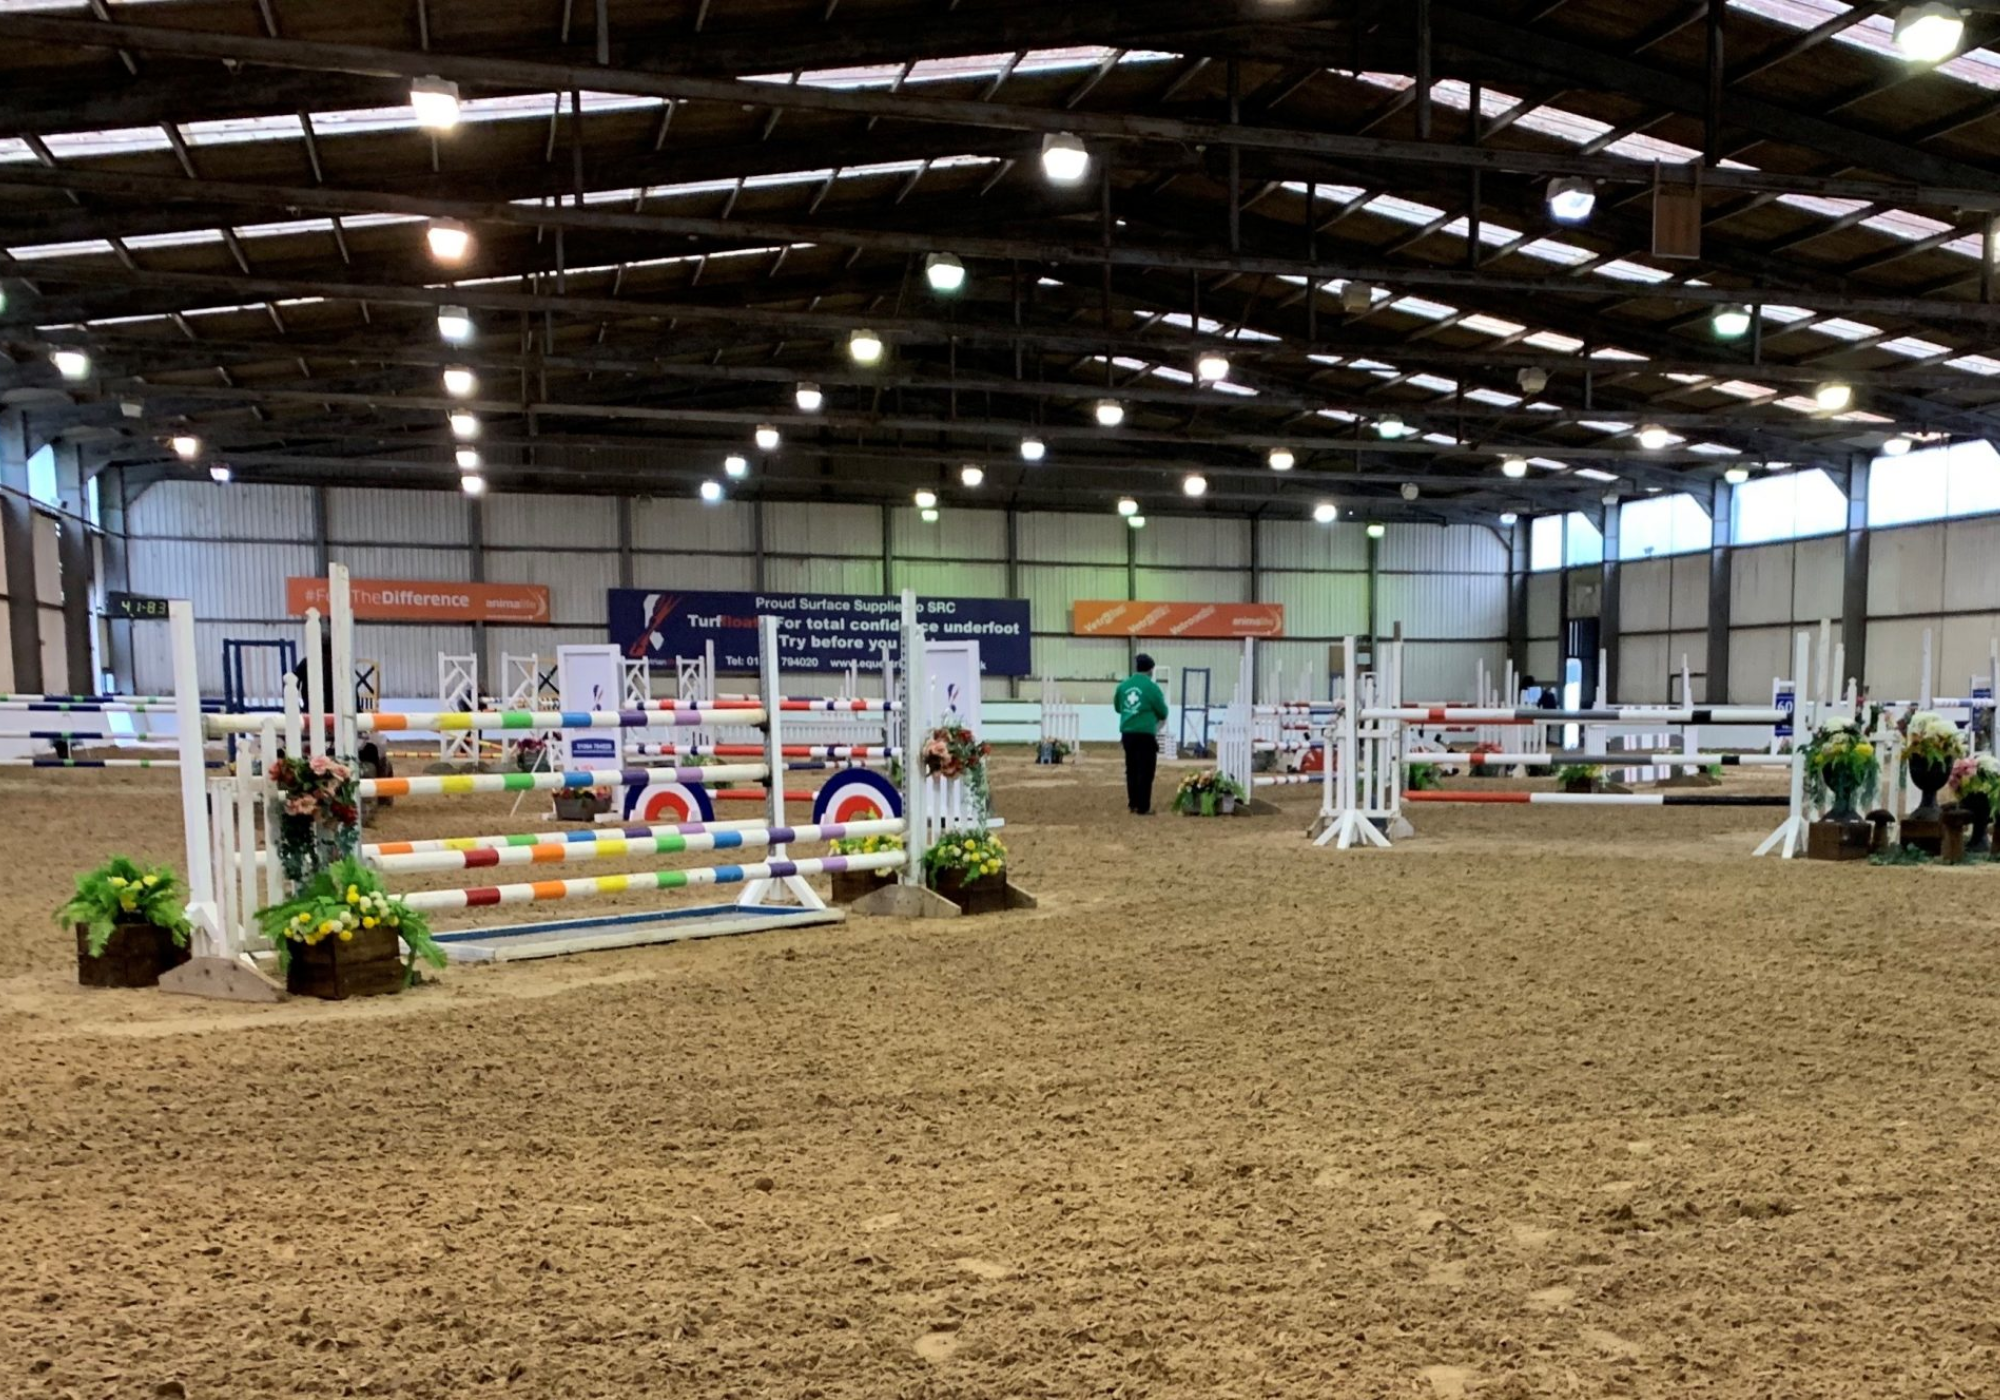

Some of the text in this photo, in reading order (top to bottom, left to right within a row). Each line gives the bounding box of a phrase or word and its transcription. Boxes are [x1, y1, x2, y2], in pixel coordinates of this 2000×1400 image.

[305, 588, 469, 608] #FTheDifference
[755, 597, 796, 609] Proud
[799, 598, 850, 612] Surface
[854, 599, 903, 615] Supplie
[927, 602, 956, 614] SRC
[777, 617, 1020, 635] For total confidce underfoot
[779, 634, 898, 652] Try before you
[725, 656, 744, 666] Tel:
[781, 657, 819, 667] 794020
